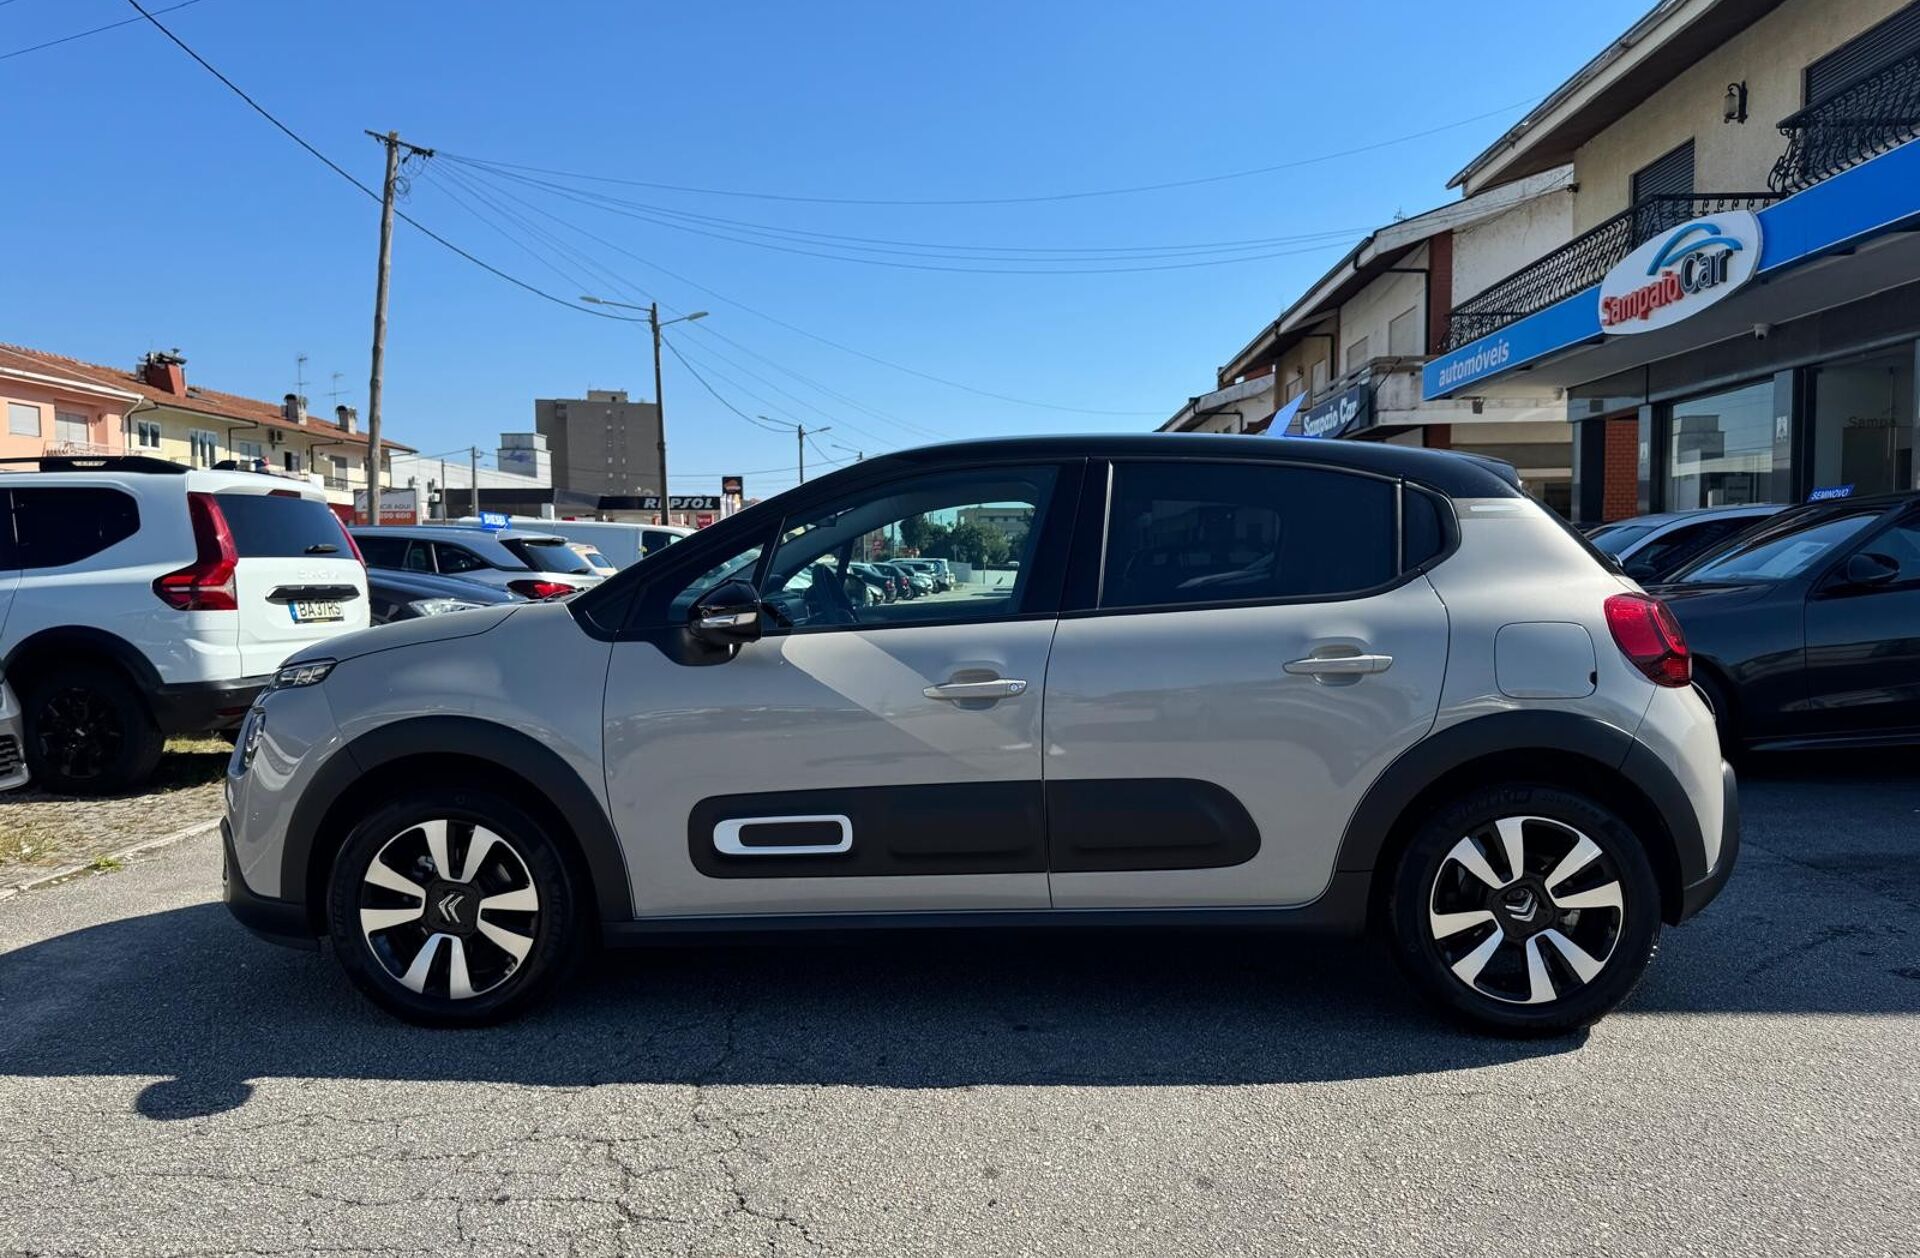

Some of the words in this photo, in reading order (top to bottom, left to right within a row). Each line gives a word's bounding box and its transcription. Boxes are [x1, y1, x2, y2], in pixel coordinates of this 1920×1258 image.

[1439, 338, 1509, 387] automóveis
[1303, 405, 1338, 437] Sampaio
[1340, 397, 1358, 424] Car
